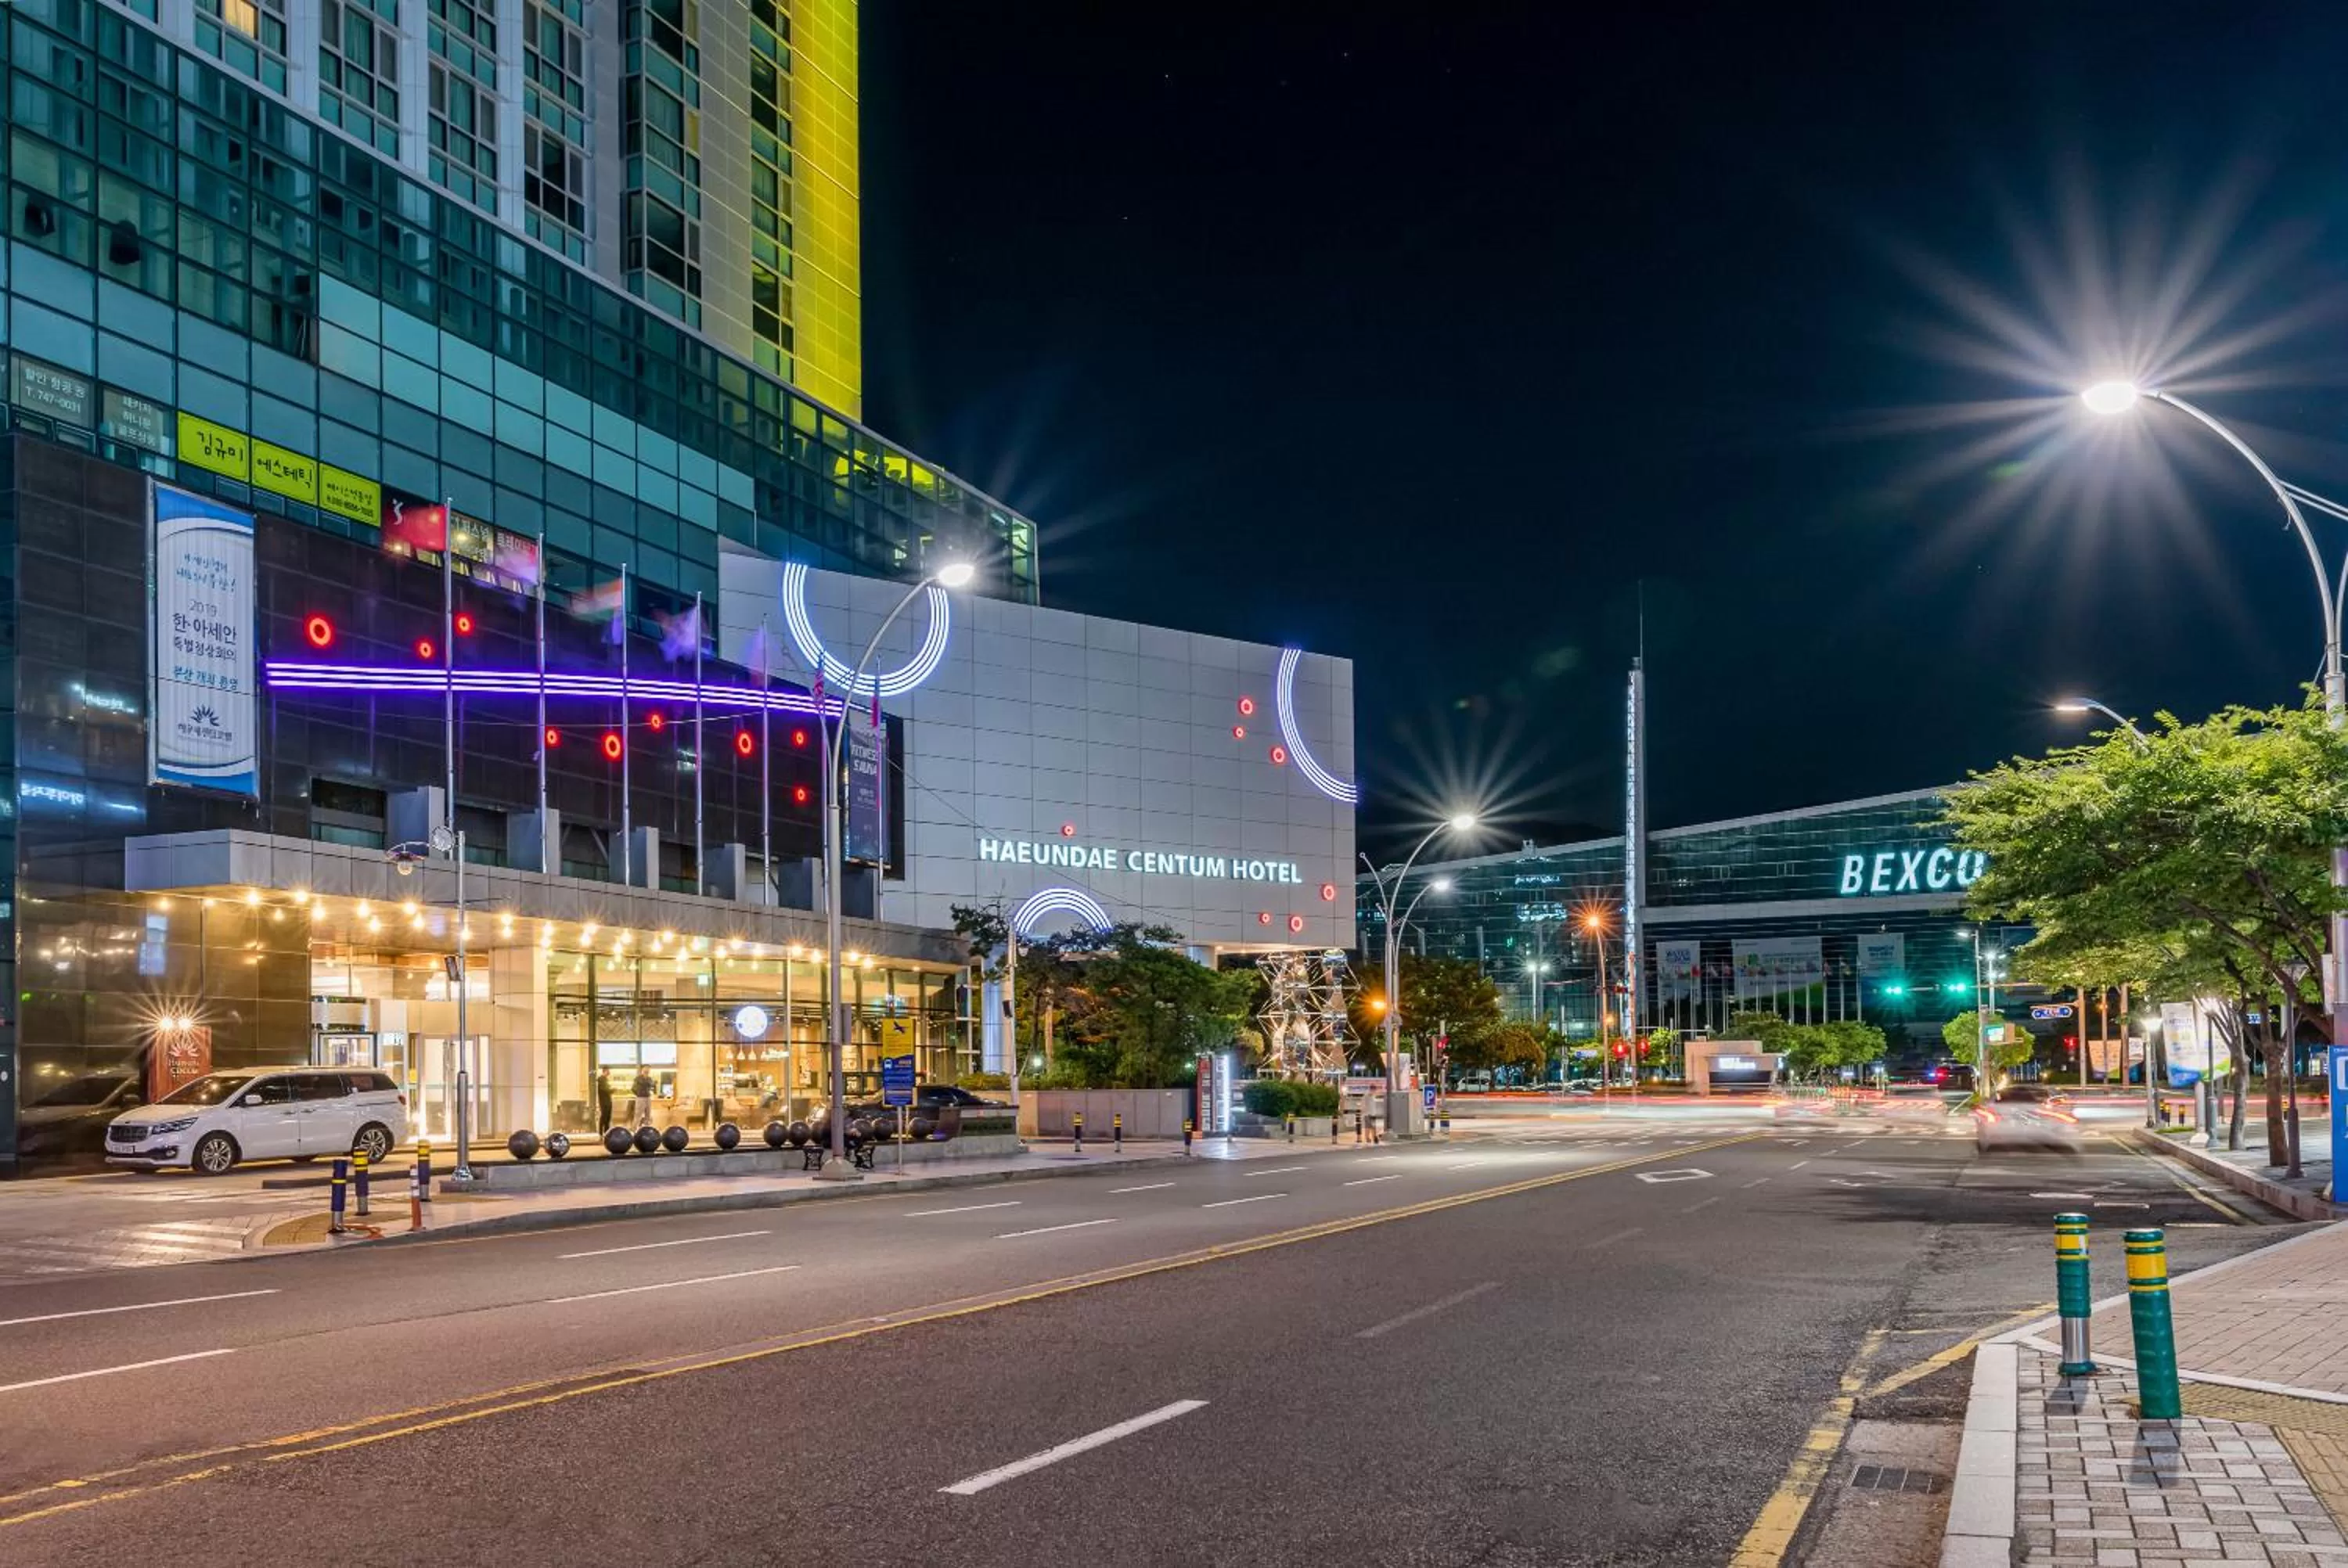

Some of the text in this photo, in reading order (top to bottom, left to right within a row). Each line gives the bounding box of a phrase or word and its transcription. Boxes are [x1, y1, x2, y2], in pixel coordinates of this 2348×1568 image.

[196, 431, 243, 462] 김규미
[256, 459, 313, 489] 에스테틱
[980, 839, 1303, 884] HAEUNDAE CENTUM HOTEL
[1840, 847, 1985, 894] BEXCO
[1427, 1090, 1434, 1104] P
